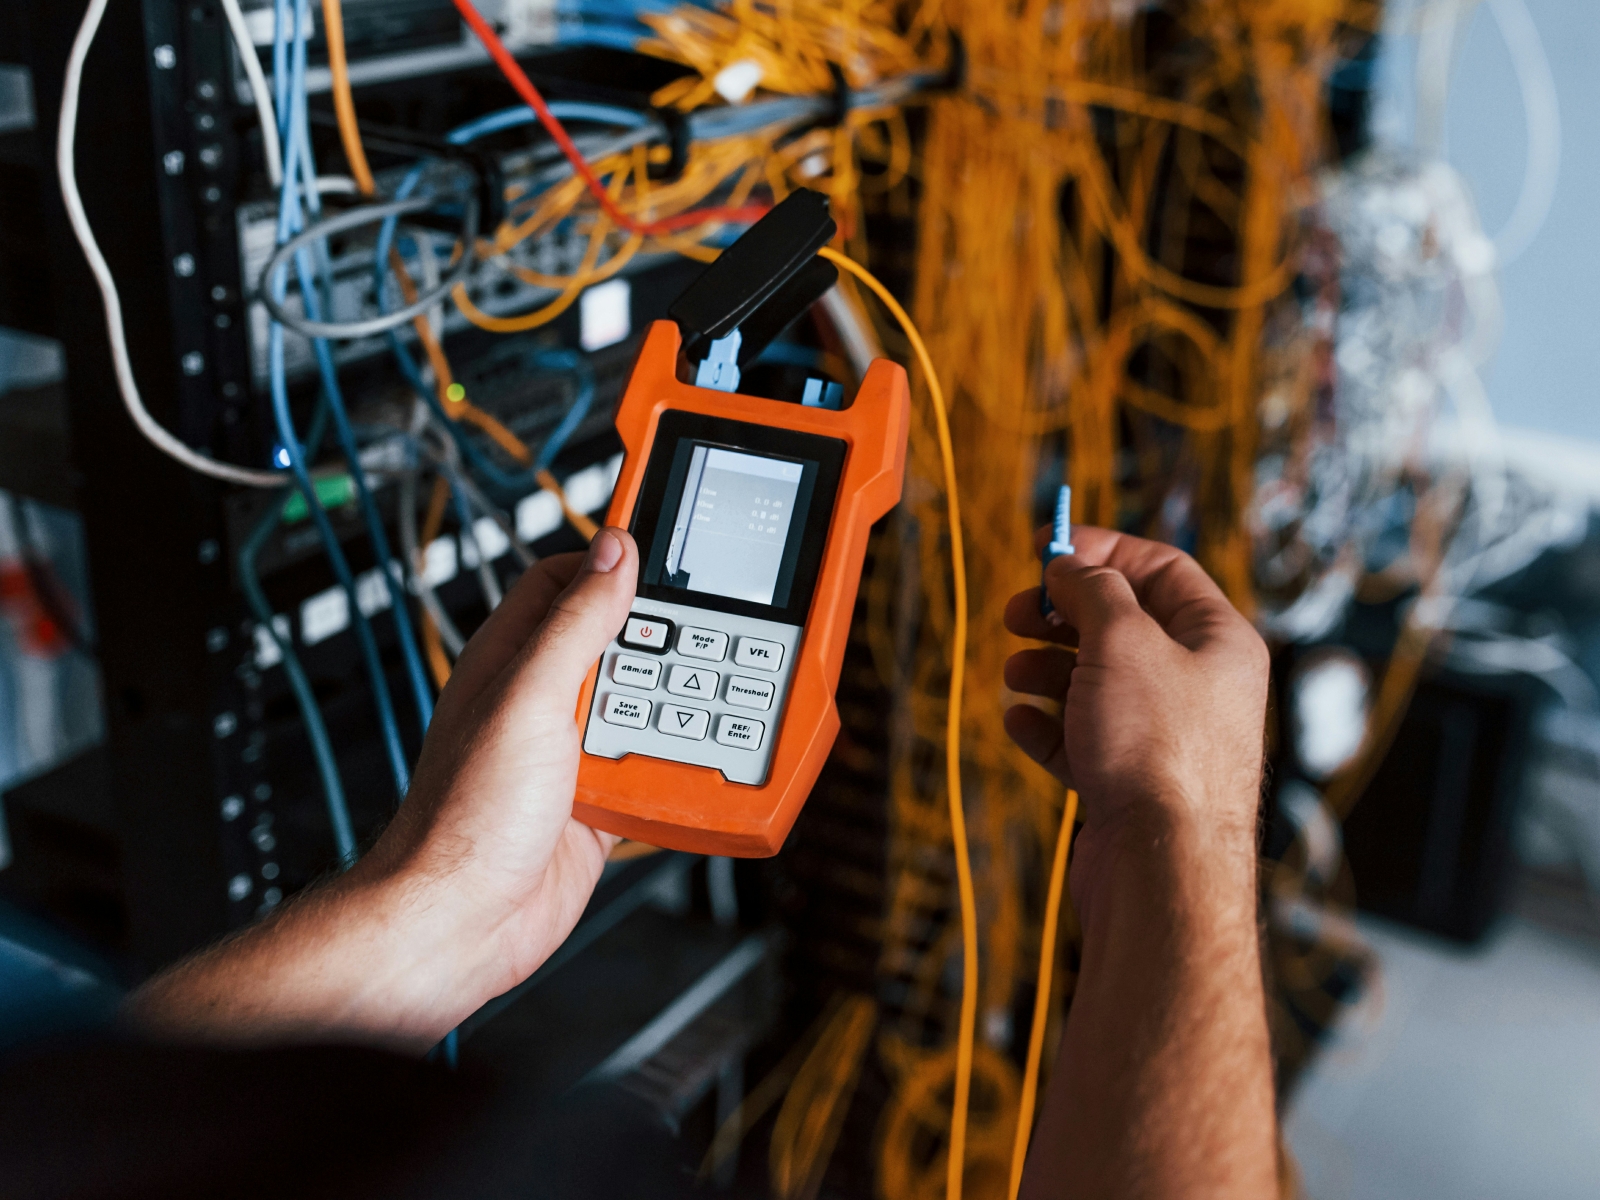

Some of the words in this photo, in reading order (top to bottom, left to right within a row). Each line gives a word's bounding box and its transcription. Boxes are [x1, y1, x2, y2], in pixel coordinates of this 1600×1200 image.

[691, 634, 715, 644] Mode
[695, 642, 709, 650] F/P
[749, 647, 770, 658] VFL
[621, 664, 654, 676] dBm/dB
[731, 685, 769, 698] Threshold
[618, 701, 638, 711] Save
[613, 707, 641, 719] ReCall
[731, 723, 751, 733] REF/
[727, 730, 751, 740] Enter
